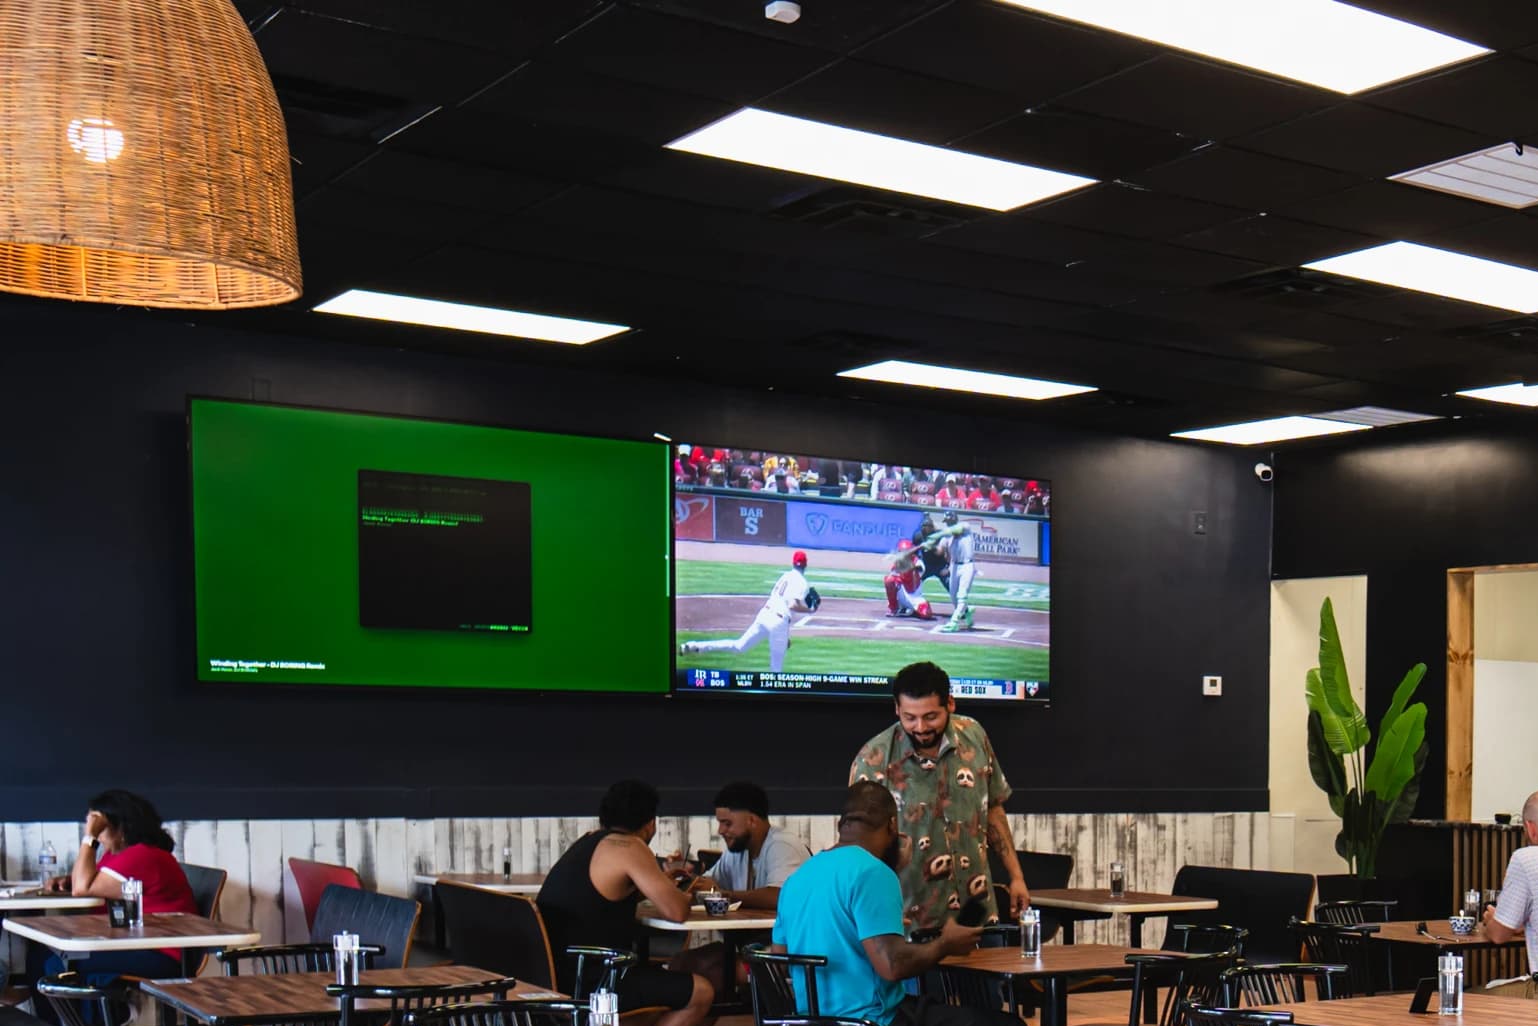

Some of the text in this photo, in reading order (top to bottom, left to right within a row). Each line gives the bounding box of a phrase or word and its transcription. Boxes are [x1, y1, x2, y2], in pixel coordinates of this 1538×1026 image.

[739, 506, 764, 518] BAR
[744, 517, 759, 535] S
[832, 519, 903, 537] FANDUEL
[977, 534, 1019, 546] AMERICAN
[996, 544, 1018, 554] PARK
[710, 679, 725, 687] BOS
[849, 676, 862, 684] WIN
[863, 677, 889, 685] STREAK
[961, 685, 973, 694] RED
[974, 686, 986, 695] SOX
